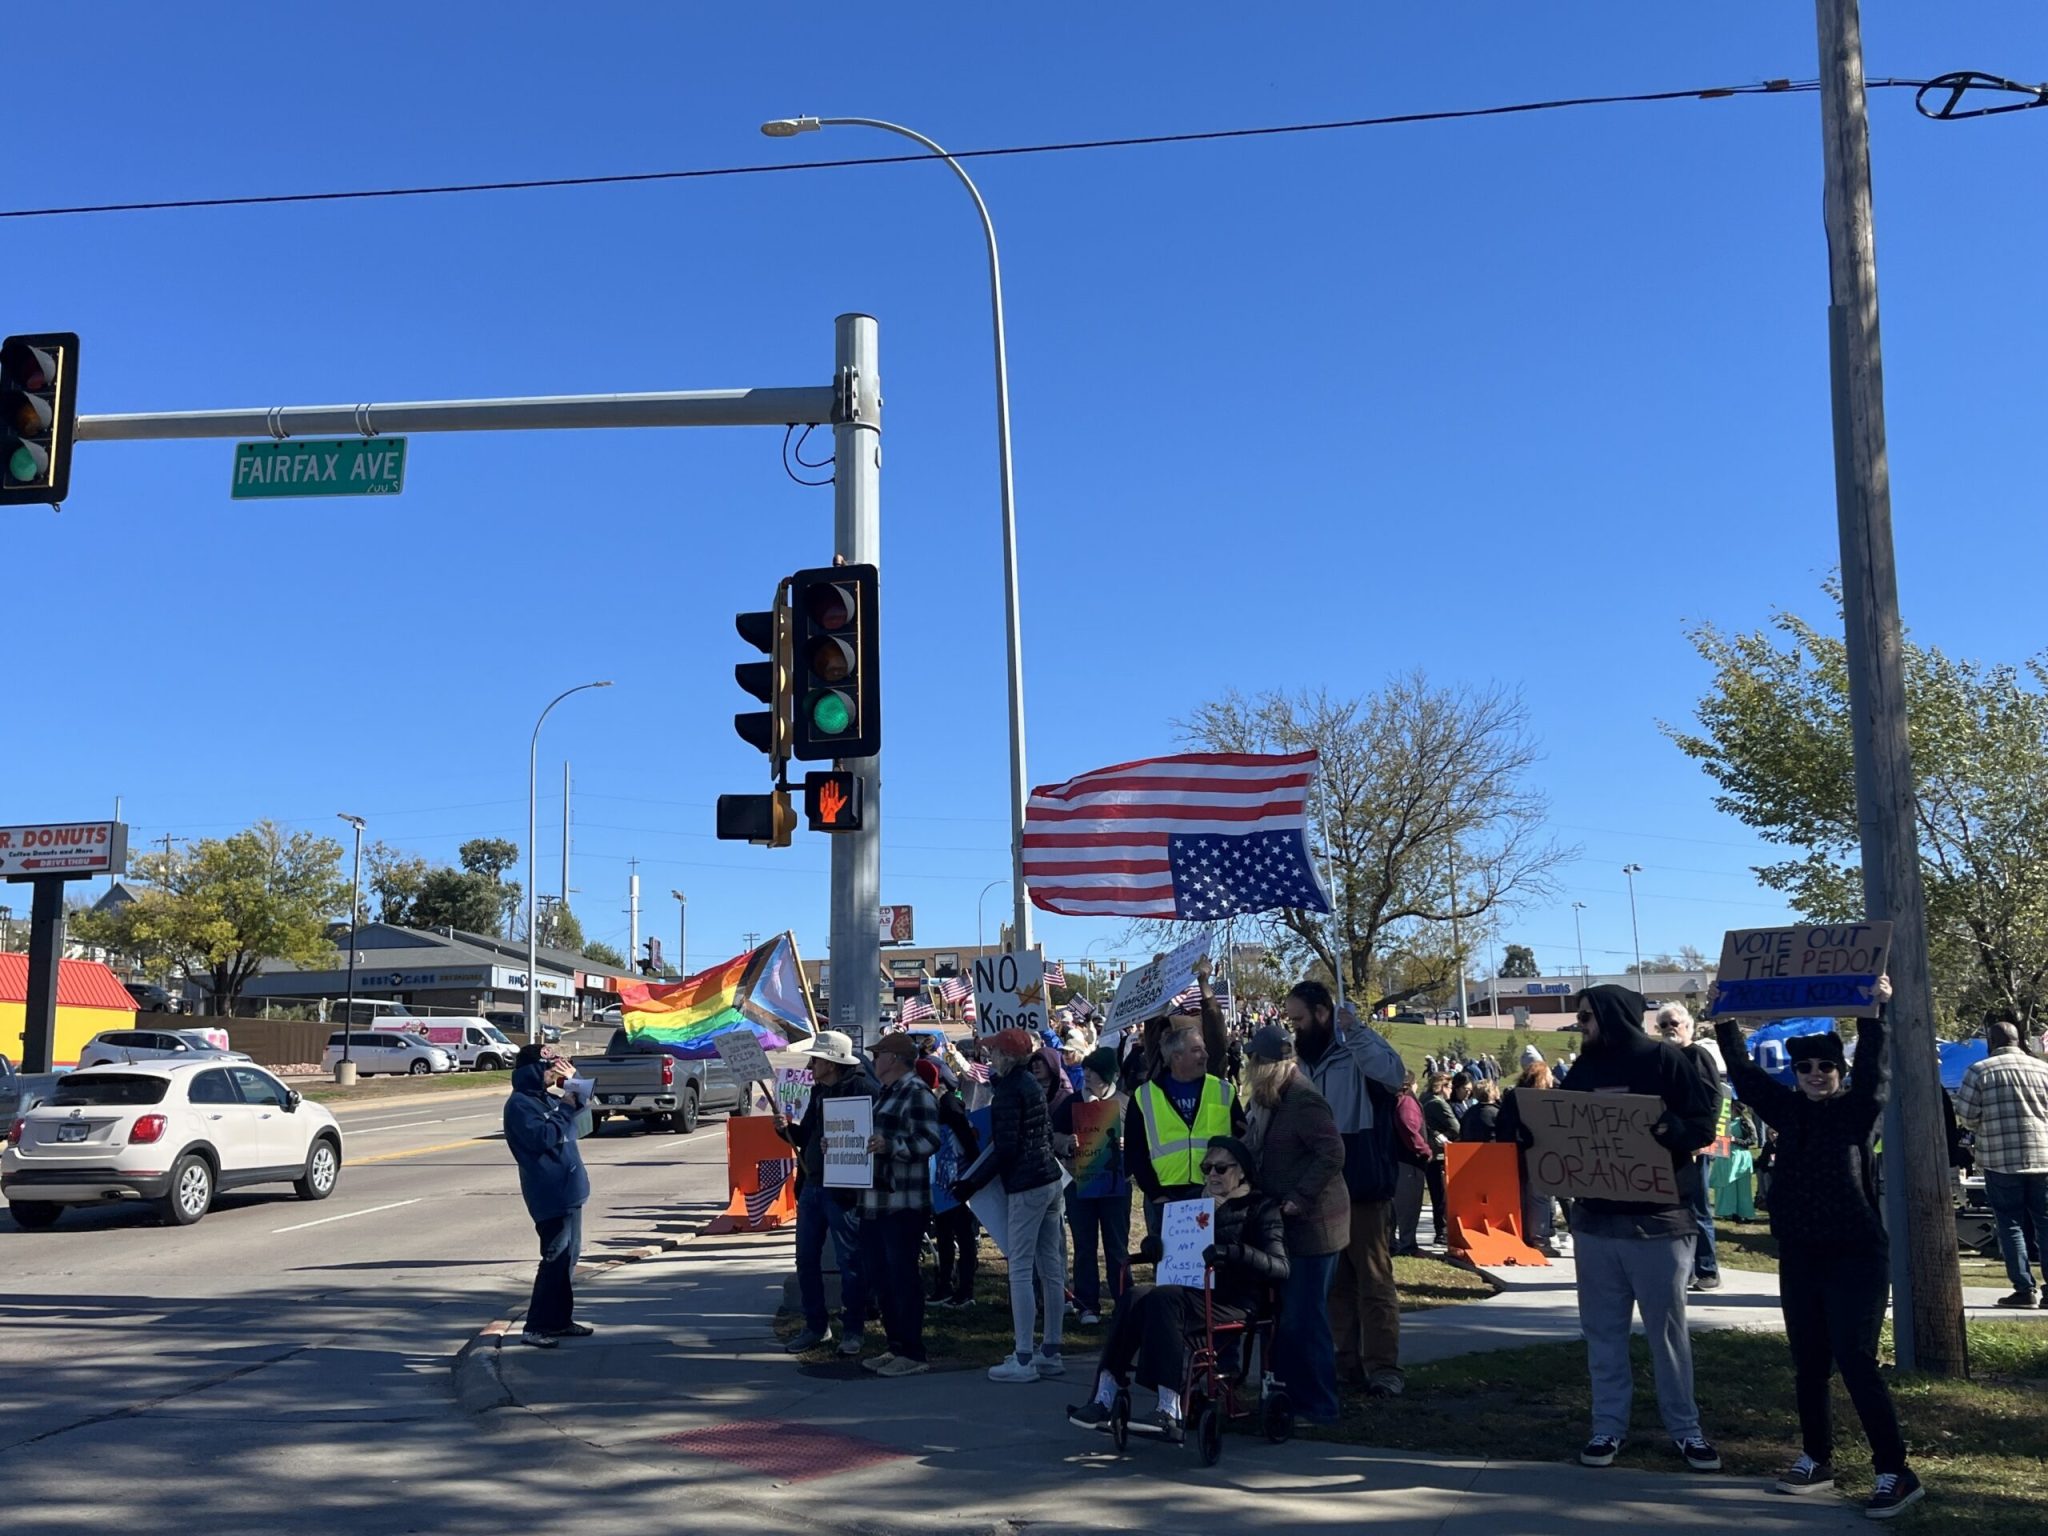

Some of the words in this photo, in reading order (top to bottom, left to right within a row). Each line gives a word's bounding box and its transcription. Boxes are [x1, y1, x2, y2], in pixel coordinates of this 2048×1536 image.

[237, 453, 340, 485] FAIRFAX
[350, 451, 399, 481] AVE
[22, 826, 107, 848] DONUTS
[40, 858, 66, 867] DRIVE
[67, 857, 91, 866] THRU
[1732, 930, 1796, 956] VOTE
[1807, 925, 1871, 949] OUT
[1743, 953, 1791, 980] THE
[1801, 946, 1882, 975] PEDO!
[361, 976, 388, 986] BEST
[404, 974, 436, 985] CARE
[975, 955, 1018, 994] NO
[1116, 984, 1164, 1010] IMMIGRAN
[1540, 983, 1572, 994] Lewis
[1113, 994, 1162, 1019] NEIGHBOR
[979, 1002, 1040, 1034] Kings
[786, 1068, 814, 1081] PEAC
[841, 1119, 855, 1133] being
[827, 1136, 839, 1149] cared
[844, 1134, 866, 1150] diversity
[1567, 1135, 1635, 1159] THE
[1538, 1151, 1675, 1195] ORANGE
[1167, 1204, 1173, 1218] I
[1168, 1226, 1201, 1237] Canada
[1164, 1255, 1205, 1272] Russia
